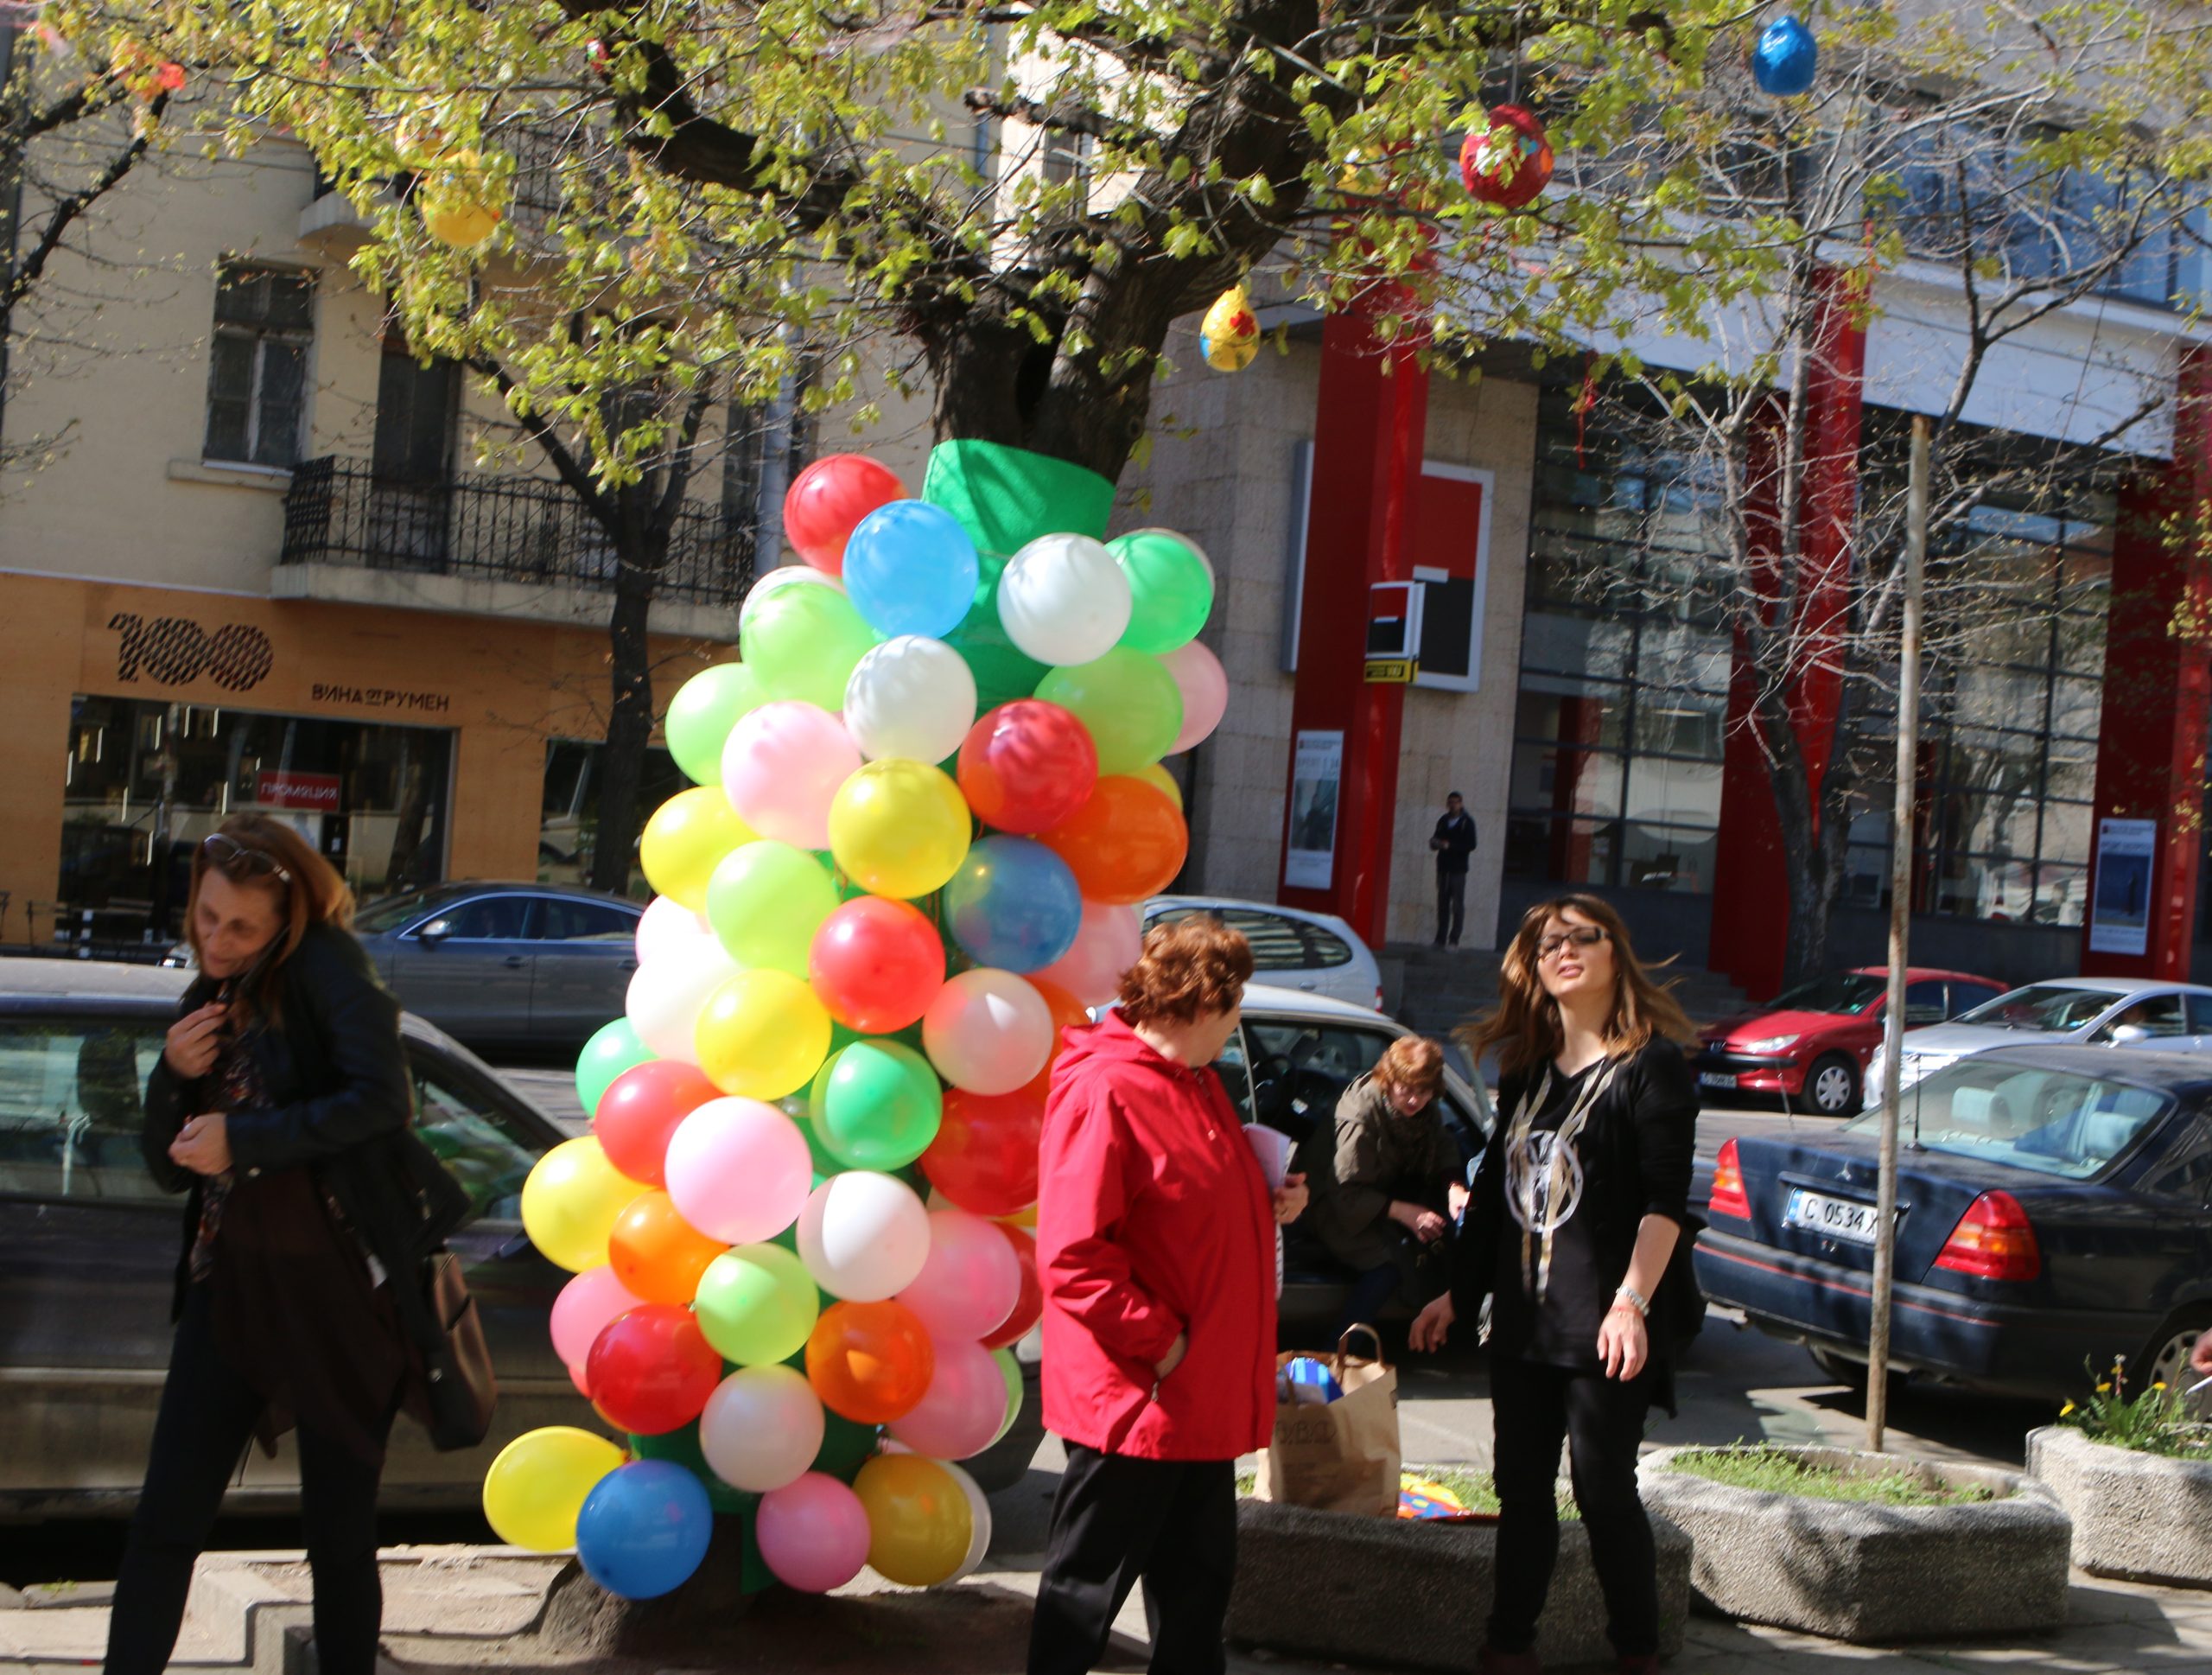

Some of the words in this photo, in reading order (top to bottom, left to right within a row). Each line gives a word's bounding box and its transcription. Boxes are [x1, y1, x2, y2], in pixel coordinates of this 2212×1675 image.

[107, 612, 273, 691] 100
[311, 683, 363, 704] ВИНА
[383, 690, 450, 713] РУМЕН
[1824, 1202, 1866, 1232] 0534
